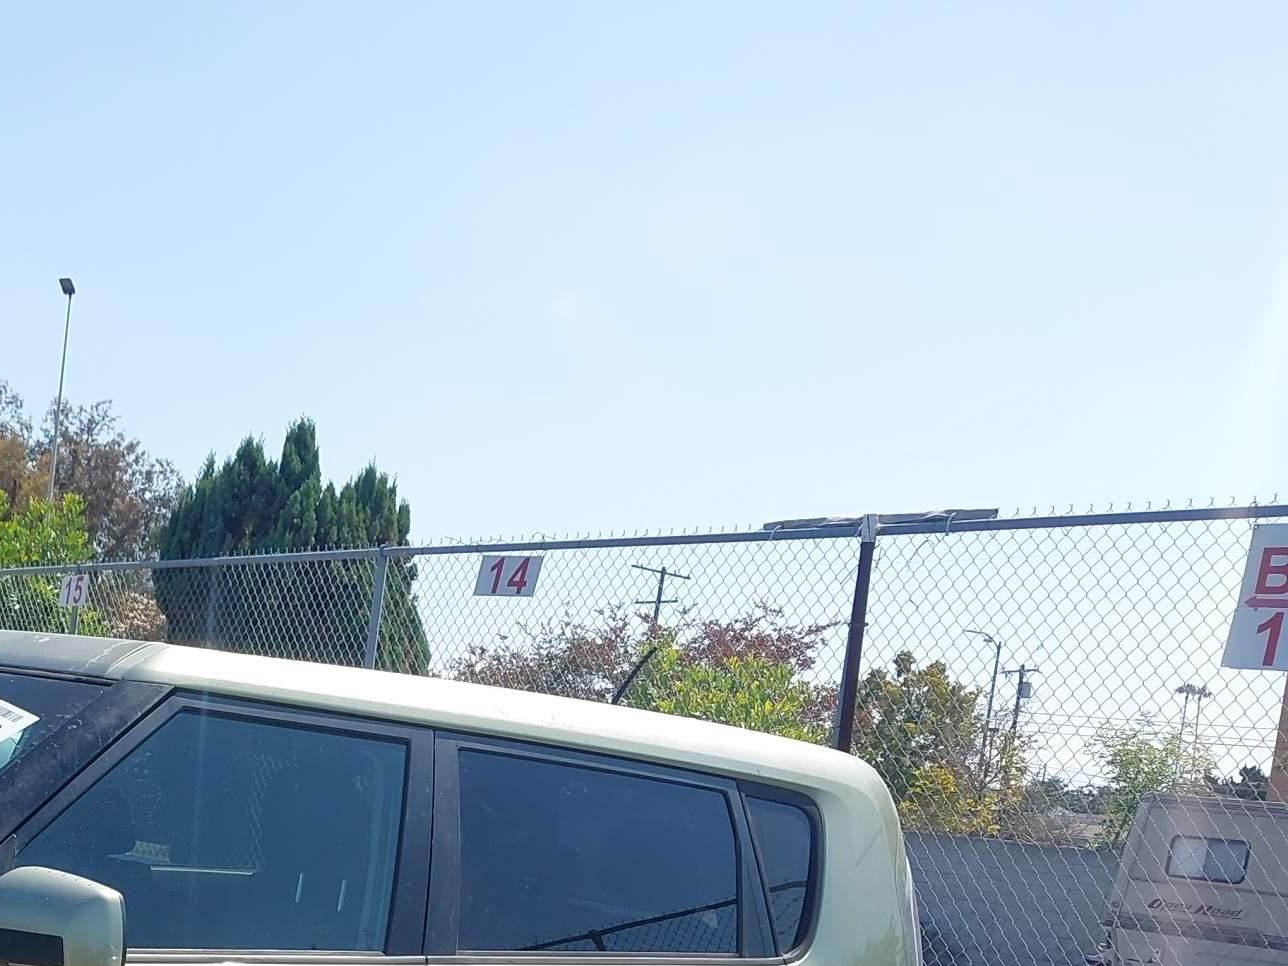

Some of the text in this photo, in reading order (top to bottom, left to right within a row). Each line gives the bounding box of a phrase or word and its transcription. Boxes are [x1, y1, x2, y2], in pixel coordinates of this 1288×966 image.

[490, 556, 532, 595] 14
[65, 576, 84, 604] 15
[1193, 904, 1243, 918] Road
